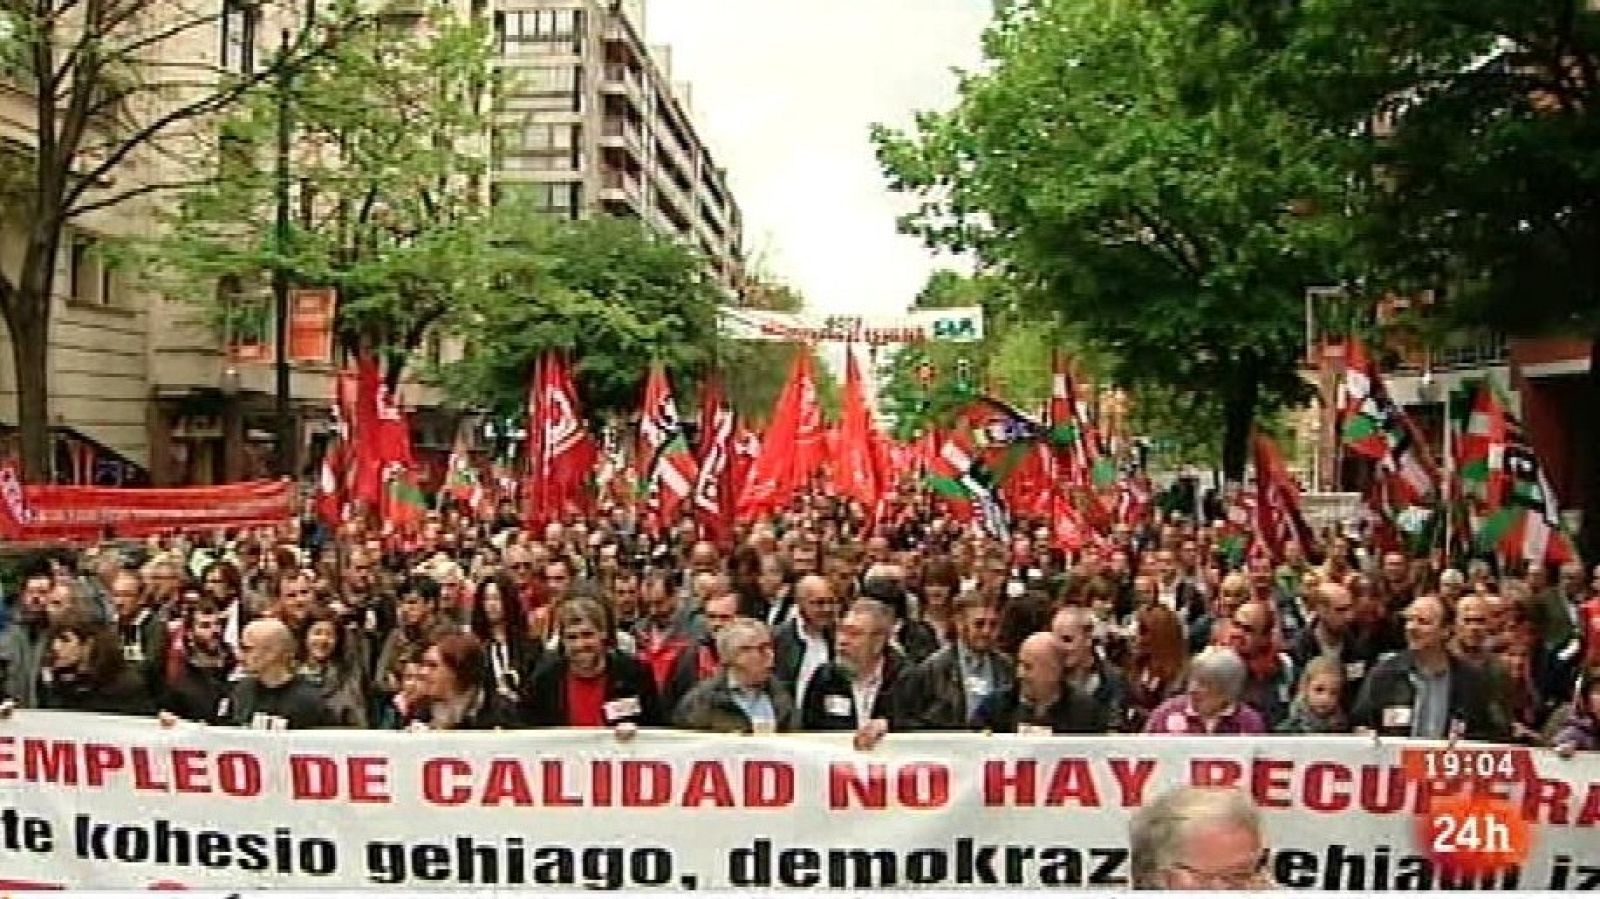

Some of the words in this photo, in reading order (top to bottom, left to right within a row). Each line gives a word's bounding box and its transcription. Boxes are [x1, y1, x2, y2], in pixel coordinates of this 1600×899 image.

[289, 753, 392, 804] DE
[422, 757, 796, 807] CALIDAD
[828, 762, 950, 810] NO
[983, 757, 1156, 808] HAY
[0, 808, 54, 853] te
[74, 813, 337, 876] kohesio
[366, 837, 697, 891] gehiago,
